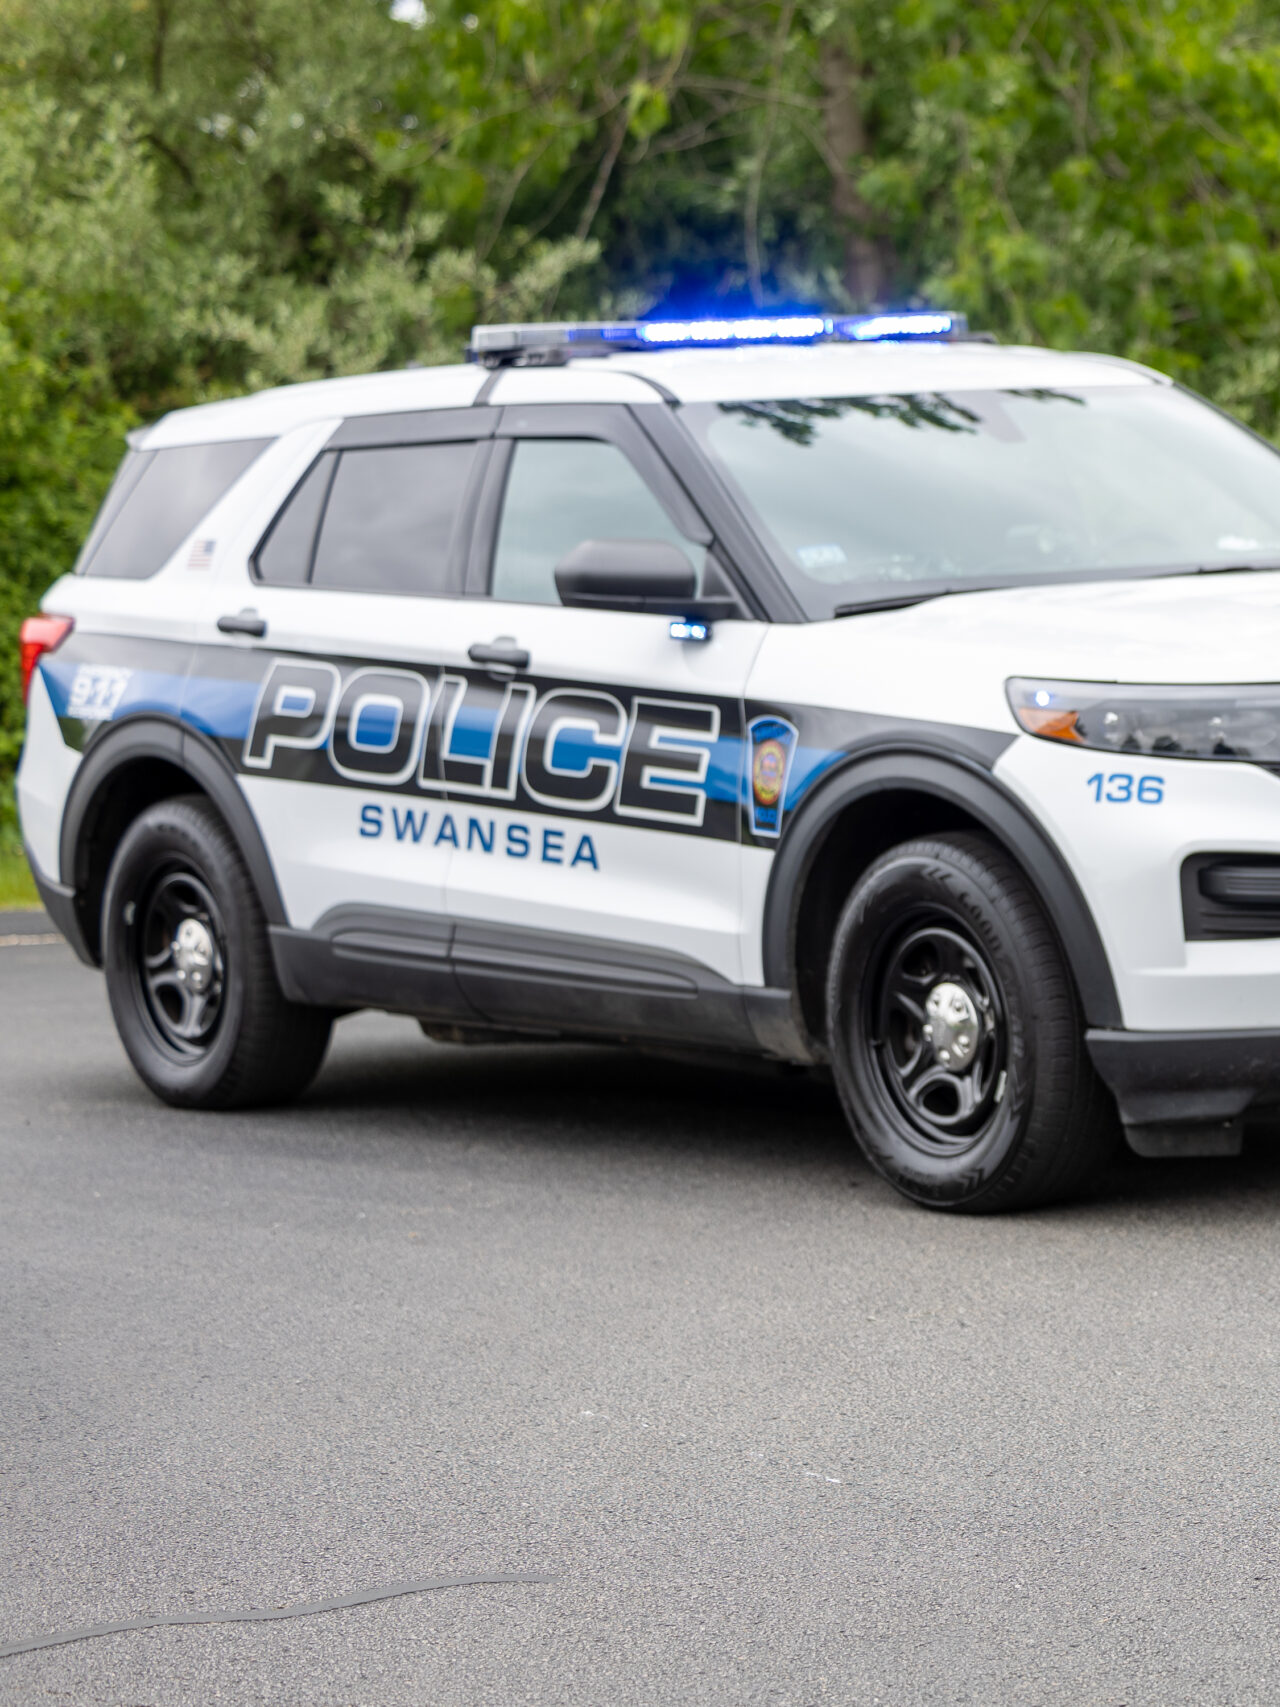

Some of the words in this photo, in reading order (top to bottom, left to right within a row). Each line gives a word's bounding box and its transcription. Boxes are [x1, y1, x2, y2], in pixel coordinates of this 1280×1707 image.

[243, 658, 721, 826] POLICE
[1087, 772, 1165, 805] 136
[359, 804, 601, 871] SWANSEA
